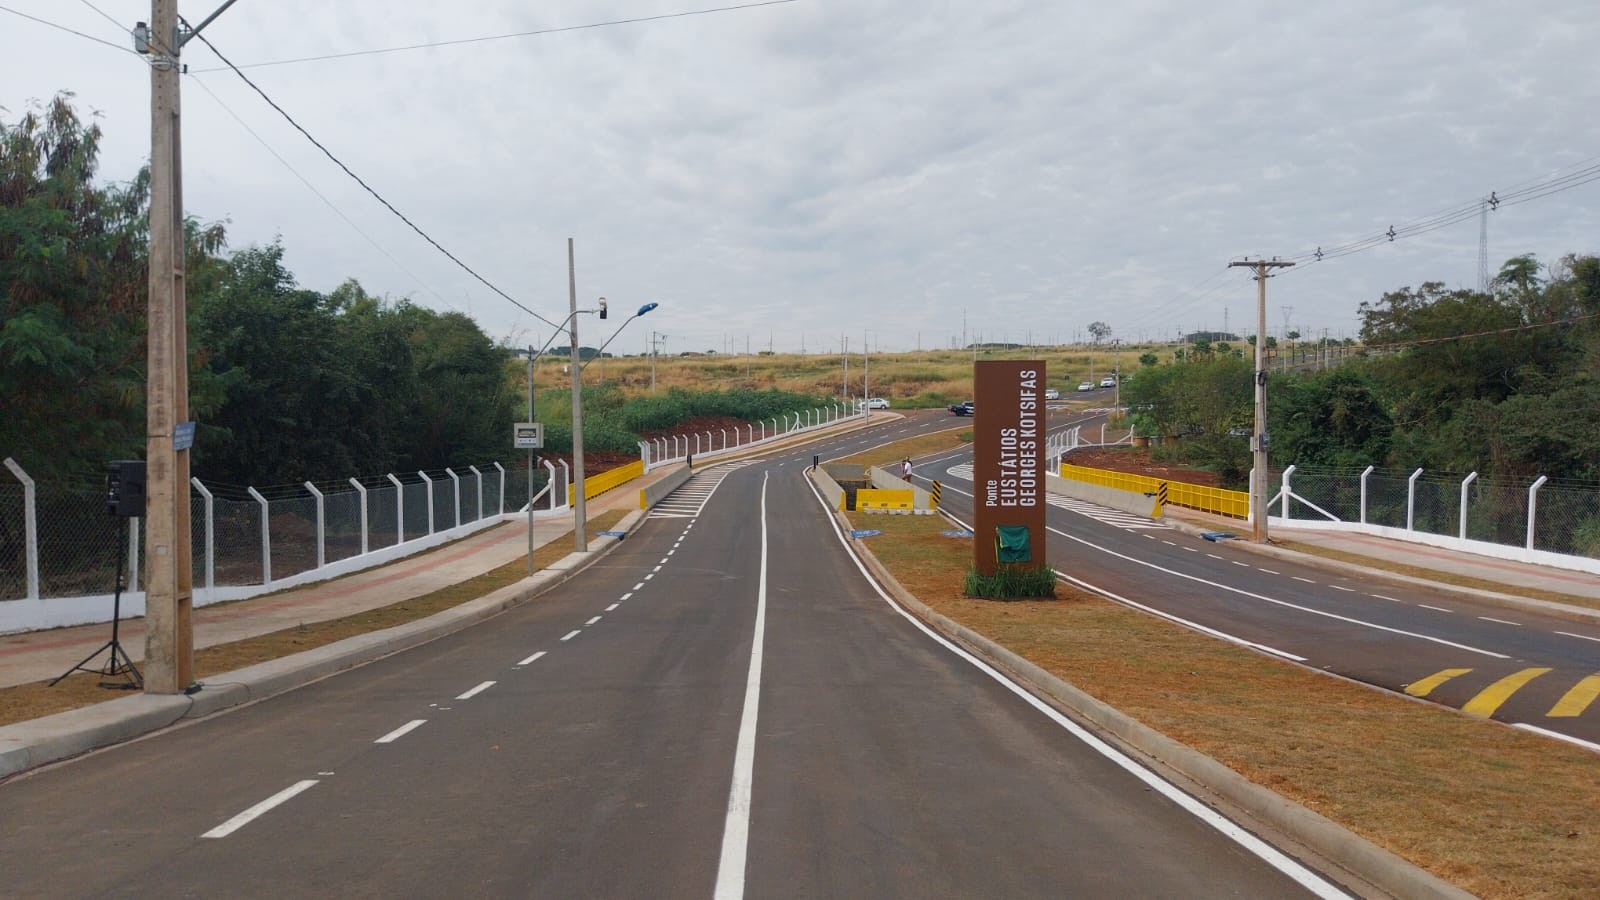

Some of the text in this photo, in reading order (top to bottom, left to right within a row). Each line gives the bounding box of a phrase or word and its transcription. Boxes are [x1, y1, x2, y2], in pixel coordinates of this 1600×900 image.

[998, 428, 1017, 506] EUSTÁTIOS
[1020, 370, 1036, 506] GEORGES KOTSIFAS
[986, 480, 997, 506] Ponte
